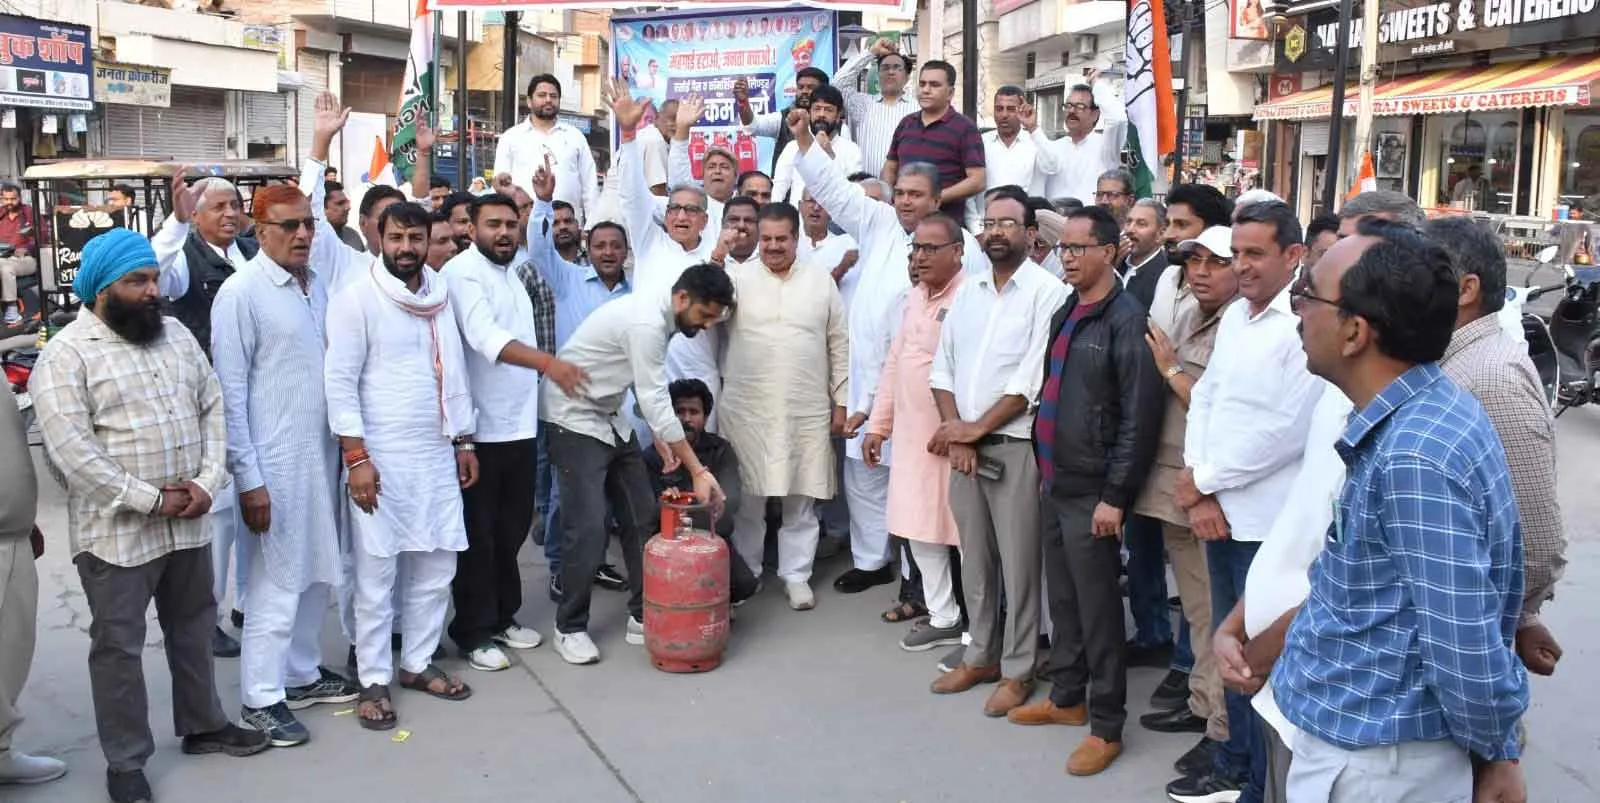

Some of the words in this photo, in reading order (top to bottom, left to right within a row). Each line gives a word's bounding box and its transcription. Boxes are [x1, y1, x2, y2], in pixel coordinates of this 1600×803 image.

[1379, 3, 1450, 43] SWEETS
[1457, 0, 1476, 31] &
[37, 32, 86, 65] शॉप
[96, 67, 125, 81] जनता
[703, 98, 736, 123] कम
[1349, 101, 1398, 114] NRAJ
[1402, 96, 1456, 112] SWEETS
[1477, 89, 1567, 107] CATERERS
